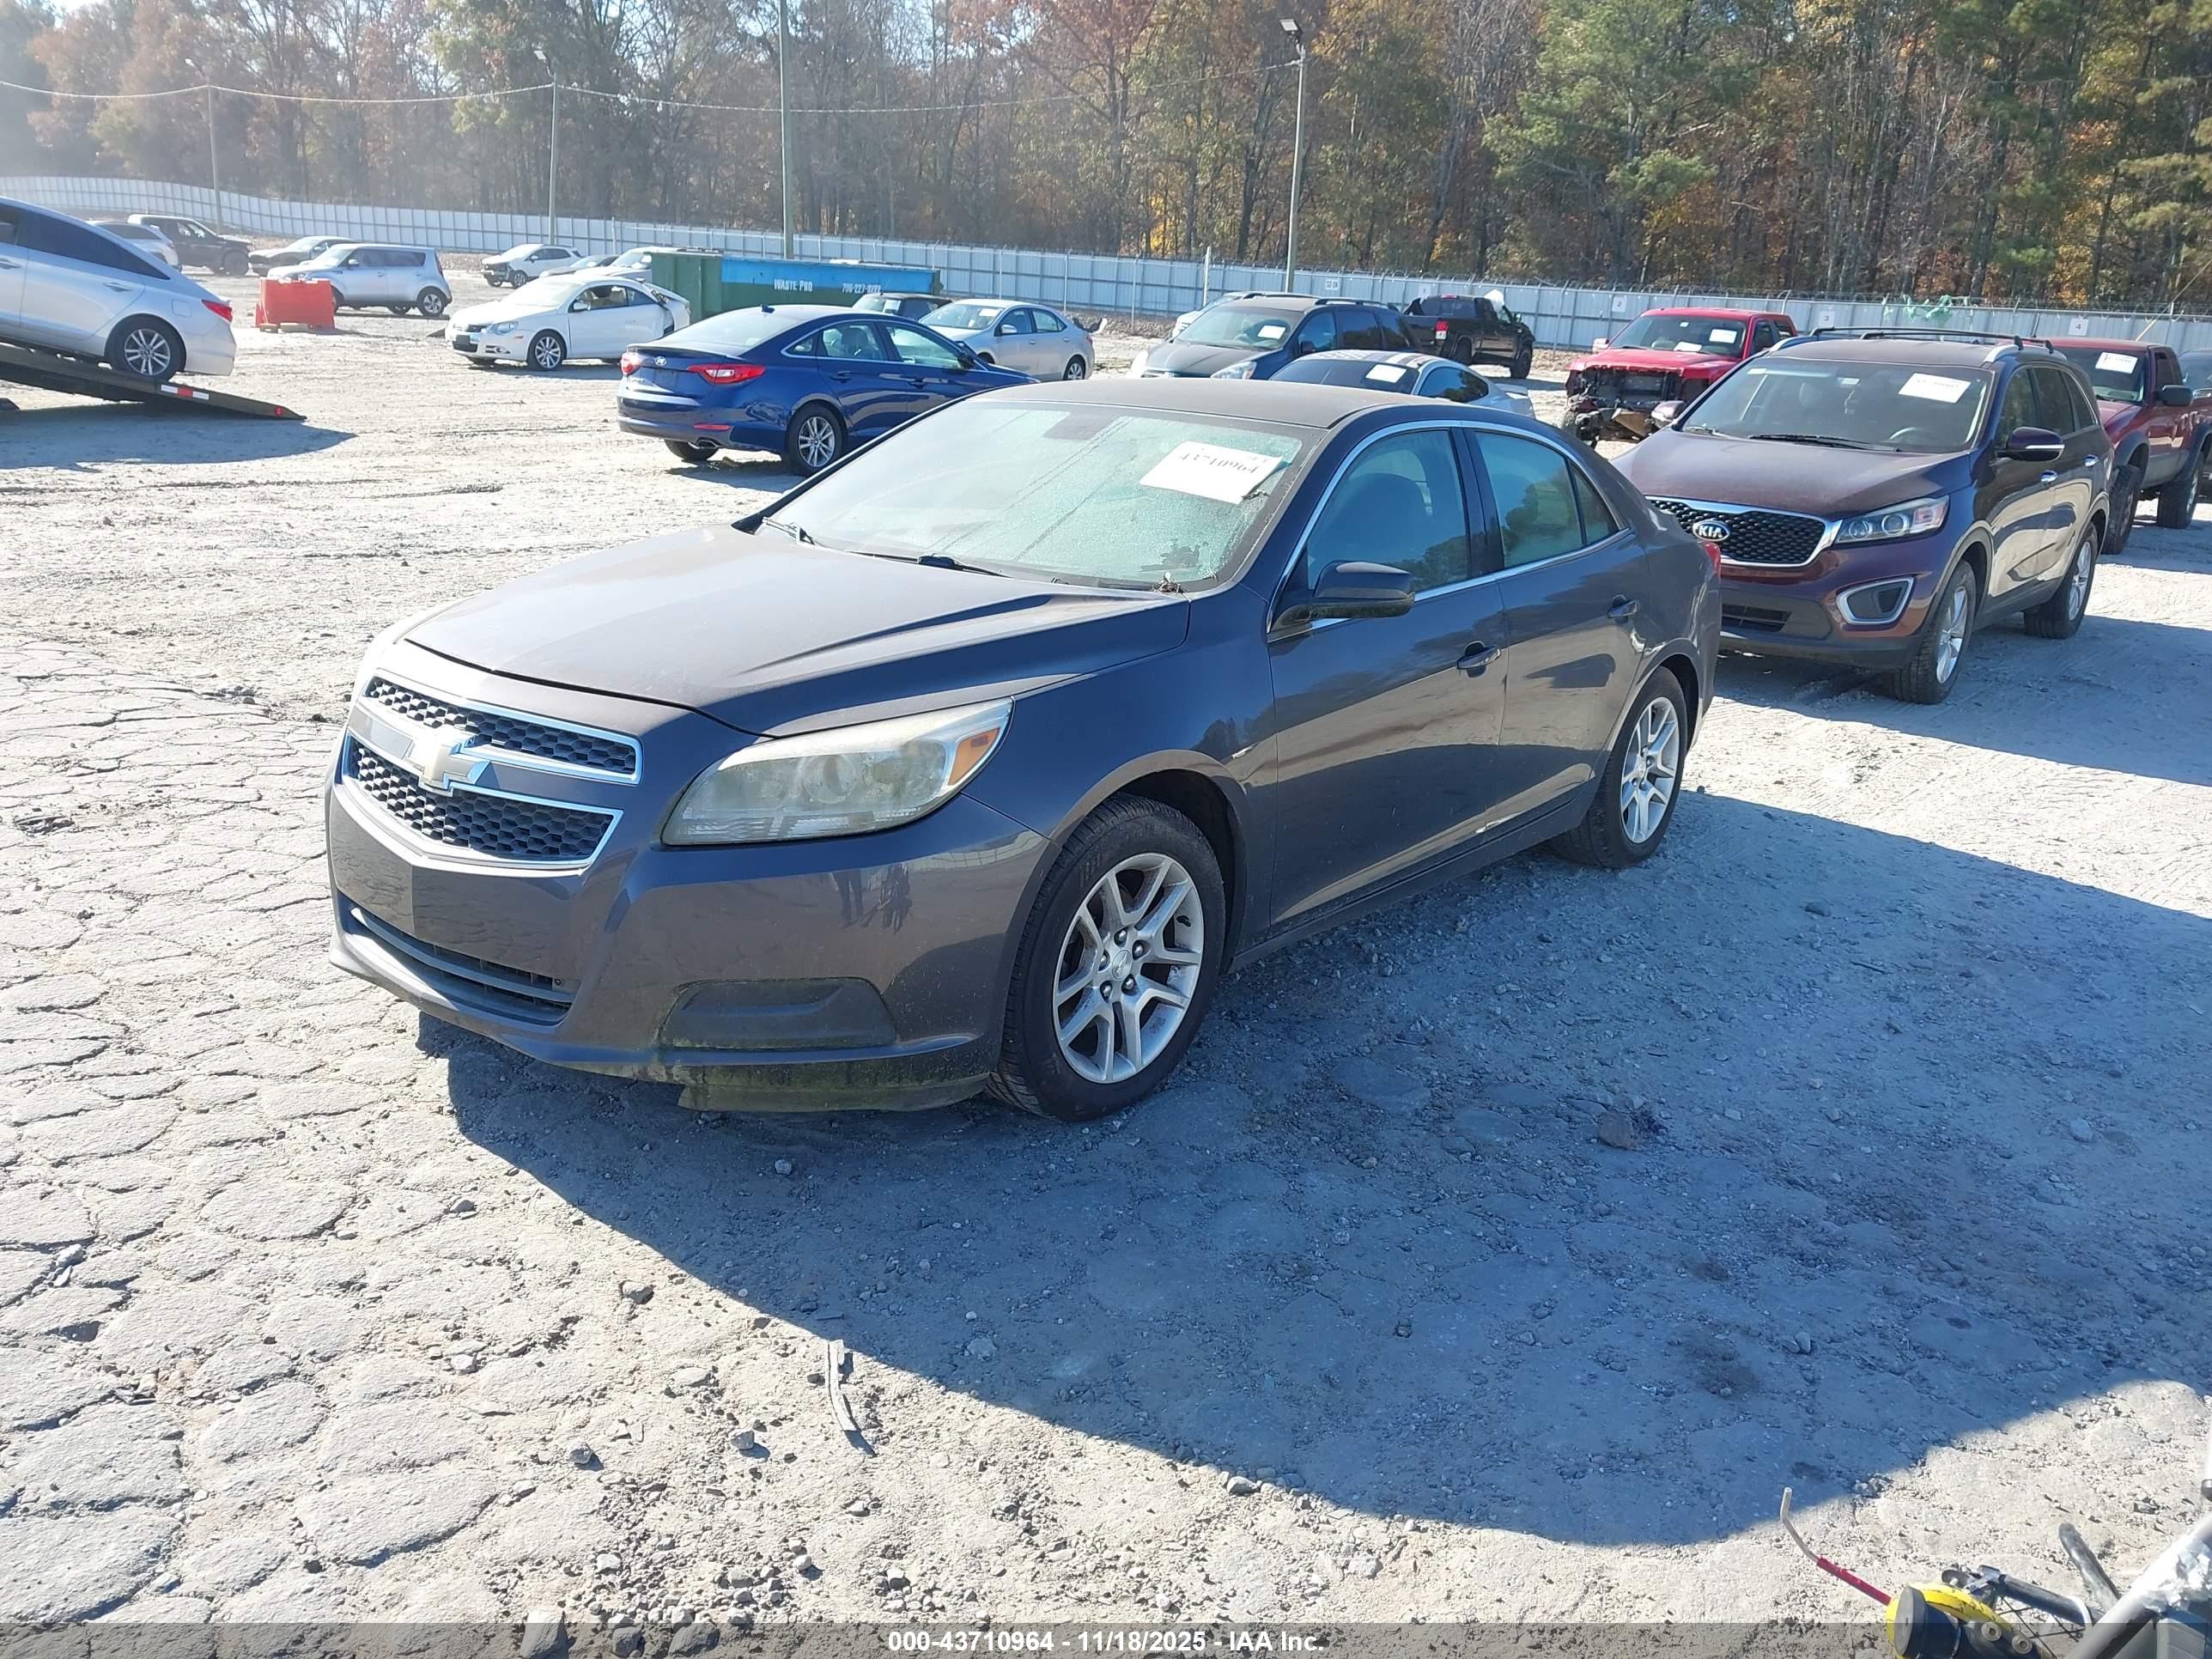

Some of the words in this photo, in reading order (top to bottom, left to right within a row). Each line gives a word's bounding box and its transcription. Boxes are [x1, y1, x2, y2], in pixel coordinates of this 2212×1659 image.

[774, 278, 798, 290] WASTE
[799, 280, 813, 292] PRO
[1698, 525, 1723, 538] KIA
